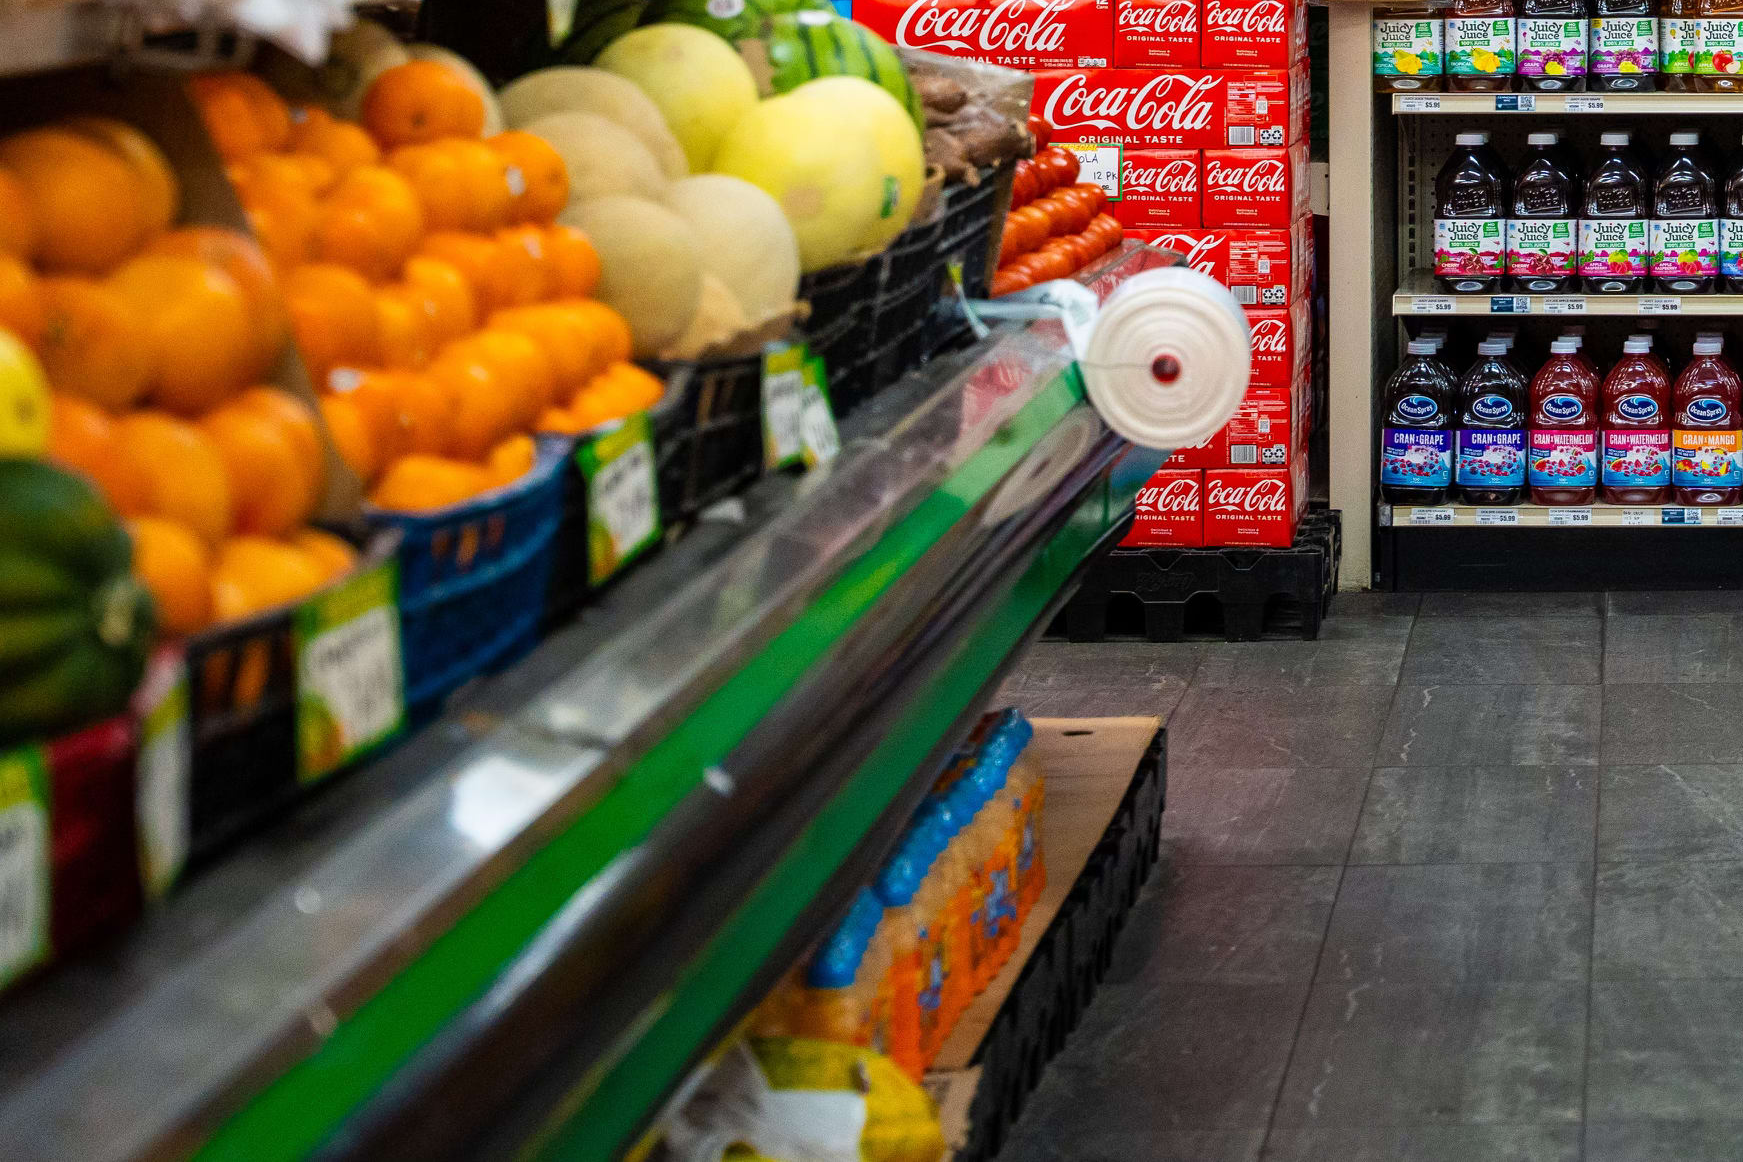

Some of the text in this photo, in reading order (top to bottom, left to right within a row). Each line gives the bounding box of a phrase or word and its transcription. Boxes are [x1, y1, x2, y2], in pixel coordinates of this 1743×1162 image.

[1457, 20, 1491, 33] Juicy
[1528, 21, 1563, 33] Juicy
[1459, 30, 1489, 39] Juice
[1531, 30, 1560, 41] Juice
[1044, 74, 1226, 129] Coca-Cola
[1078, 136, 1139, 145] ORIGINAL
[1448, 221, 1482, 235] Juicy
[1593, 222, 1628, 236] Juicy
[1450, 231, 1479, 241] Juice
[1596, 232, 1625, 241] Juice
